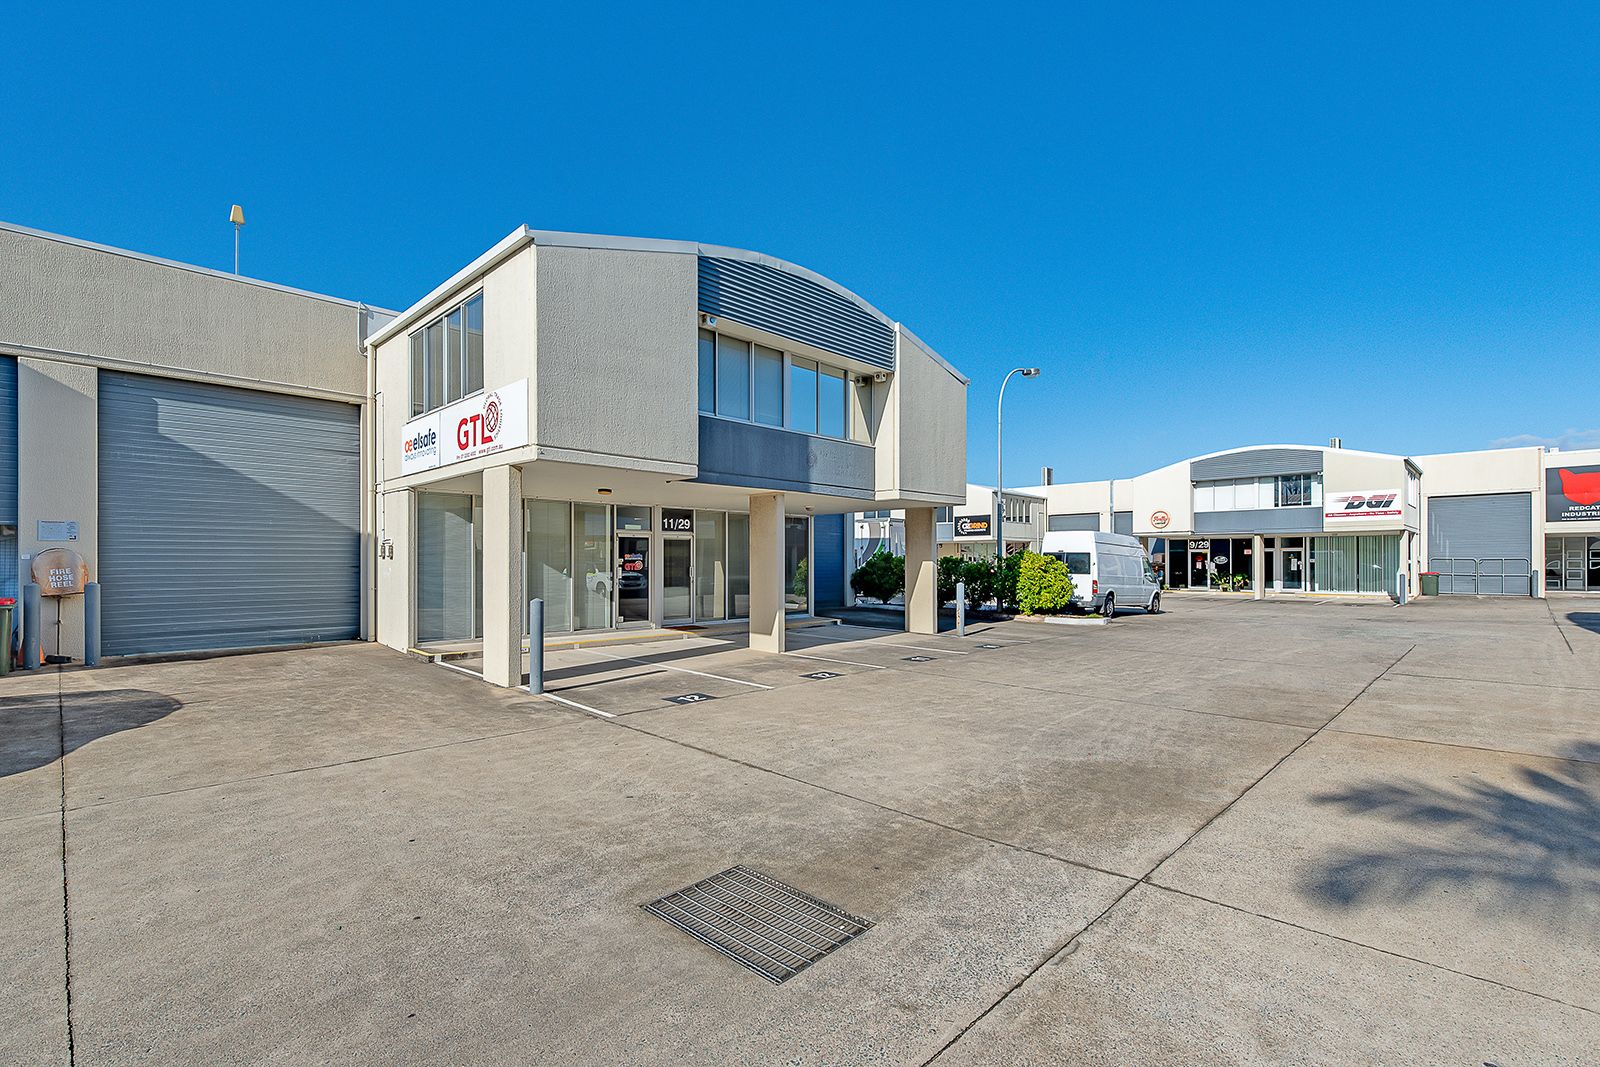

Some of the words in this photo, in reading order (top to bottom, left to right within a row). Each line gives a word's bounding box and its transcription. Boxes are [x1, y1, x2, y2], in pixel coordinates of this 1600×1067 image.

[457, 414, 493, 450] GTL
[413, 428, 437, 450] elsafe
[1344, 493, 1398, 510] DGI
[663, 518, 690, 530] 11/29
[1189, 541, 1209, 549] 9/29
[48, 574, 74, 582] HOSE
[50, 581, 74, 589] REEL
